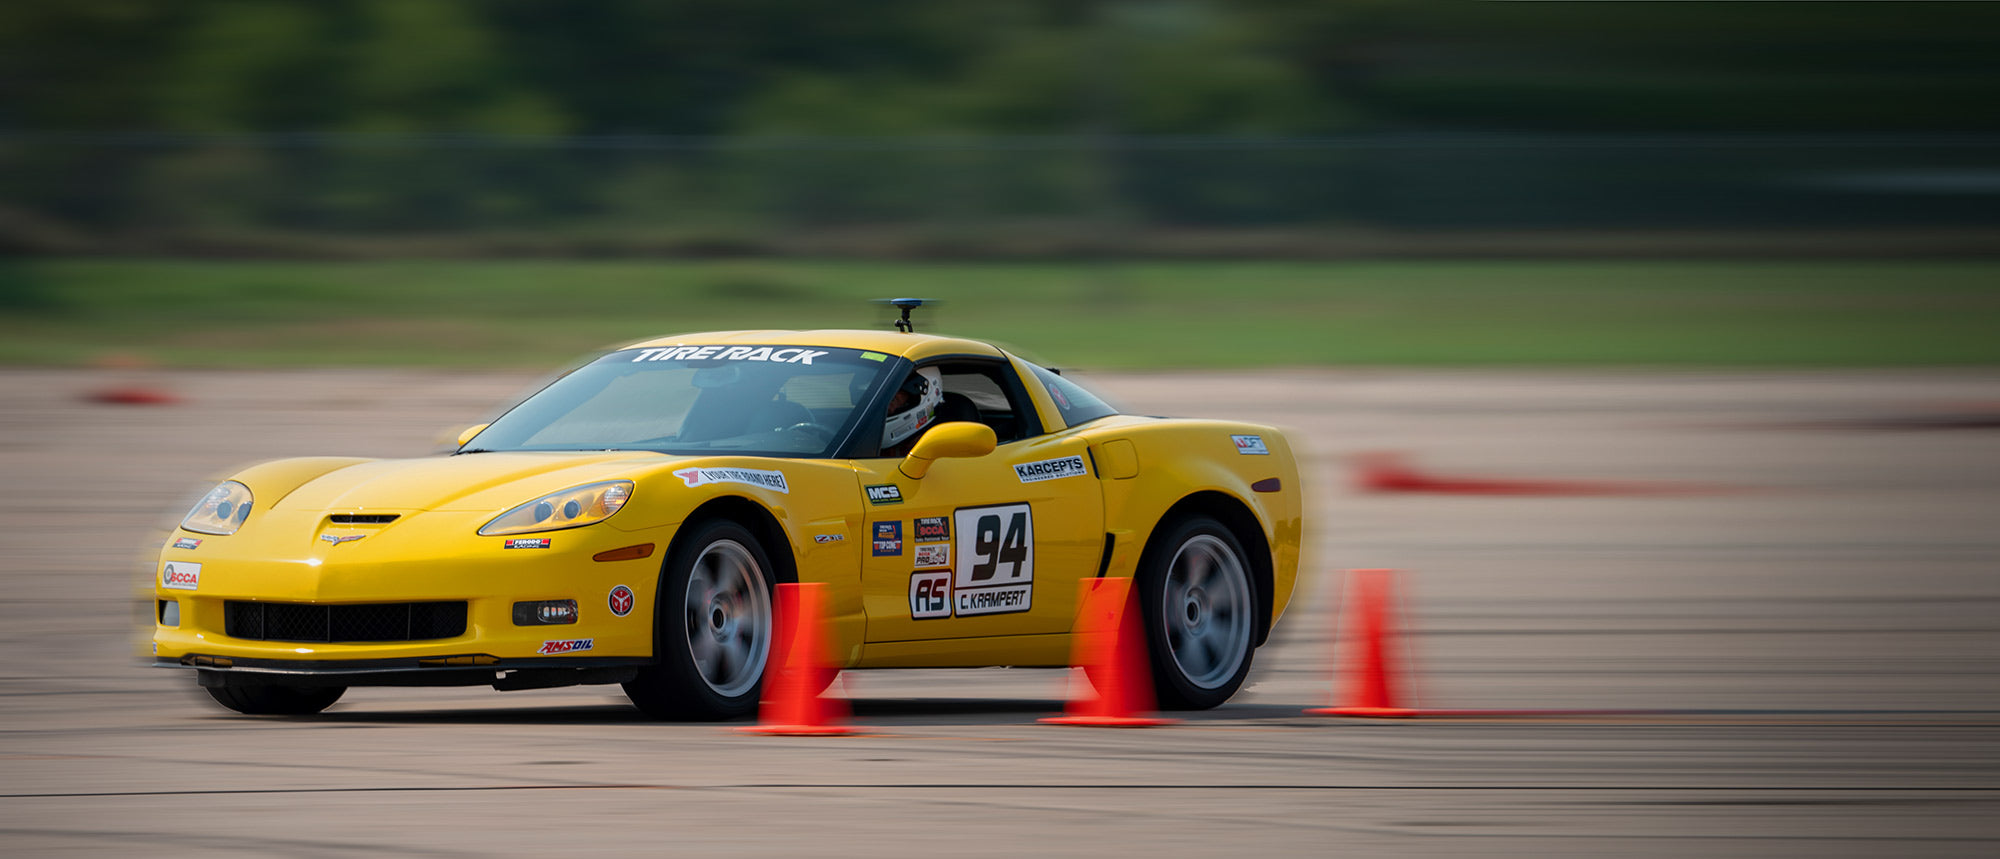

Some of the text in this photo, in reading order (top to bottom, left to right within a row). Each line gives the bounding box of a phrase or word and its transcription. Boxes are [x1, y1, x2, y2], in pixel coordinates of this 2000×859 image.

[632, 347, 829, 365] TIRE RACK
[1016, 458, 1083, 477] KARCEPTS
[868, 486, 900, 499] MCS
[920, 526, 944, 536] SCCA
[971, 511, 1028, 582] 94
[171, 572, 197, 583] SCCA
[916, 578, 948, 612] AS
[540, 639, 592, 654] AMSOIL
